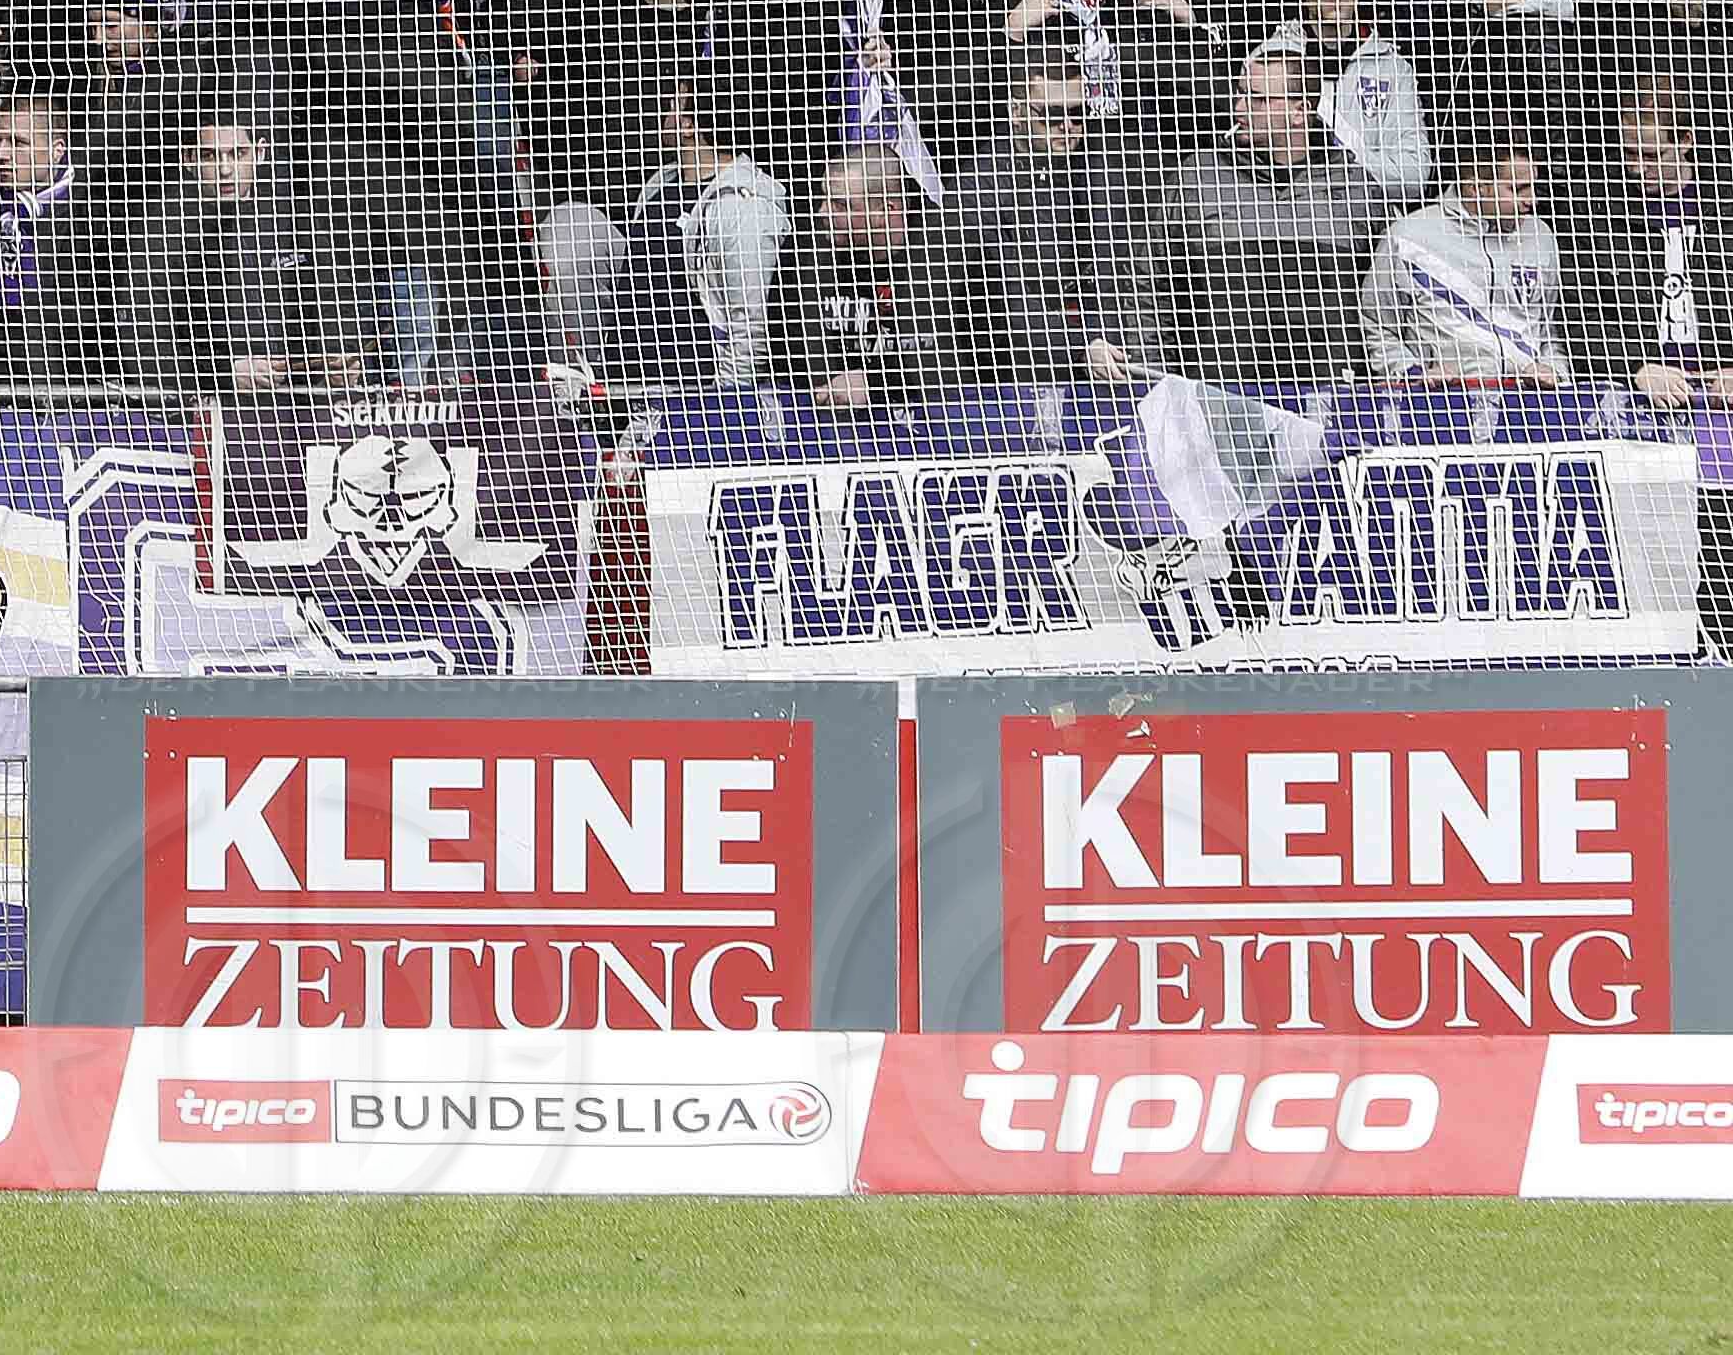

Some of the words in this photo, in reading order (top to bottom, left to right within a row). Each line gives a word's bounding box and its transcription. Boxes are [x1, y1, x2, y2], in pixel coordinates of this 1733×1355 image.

[185, 756, 776, 893] KLEINE
[1042, 748, 1633, 888] KLEINE
[183, 937, 785, 1031] ZEITUNG
[1040, 930, 1642, 1031] ZEITUNG
[176, 1087, 317, 1132] tipico
[350, 1092, 758, 1135] BUNDESLIGA
[963, 1040, 1439, 1175] tipico
